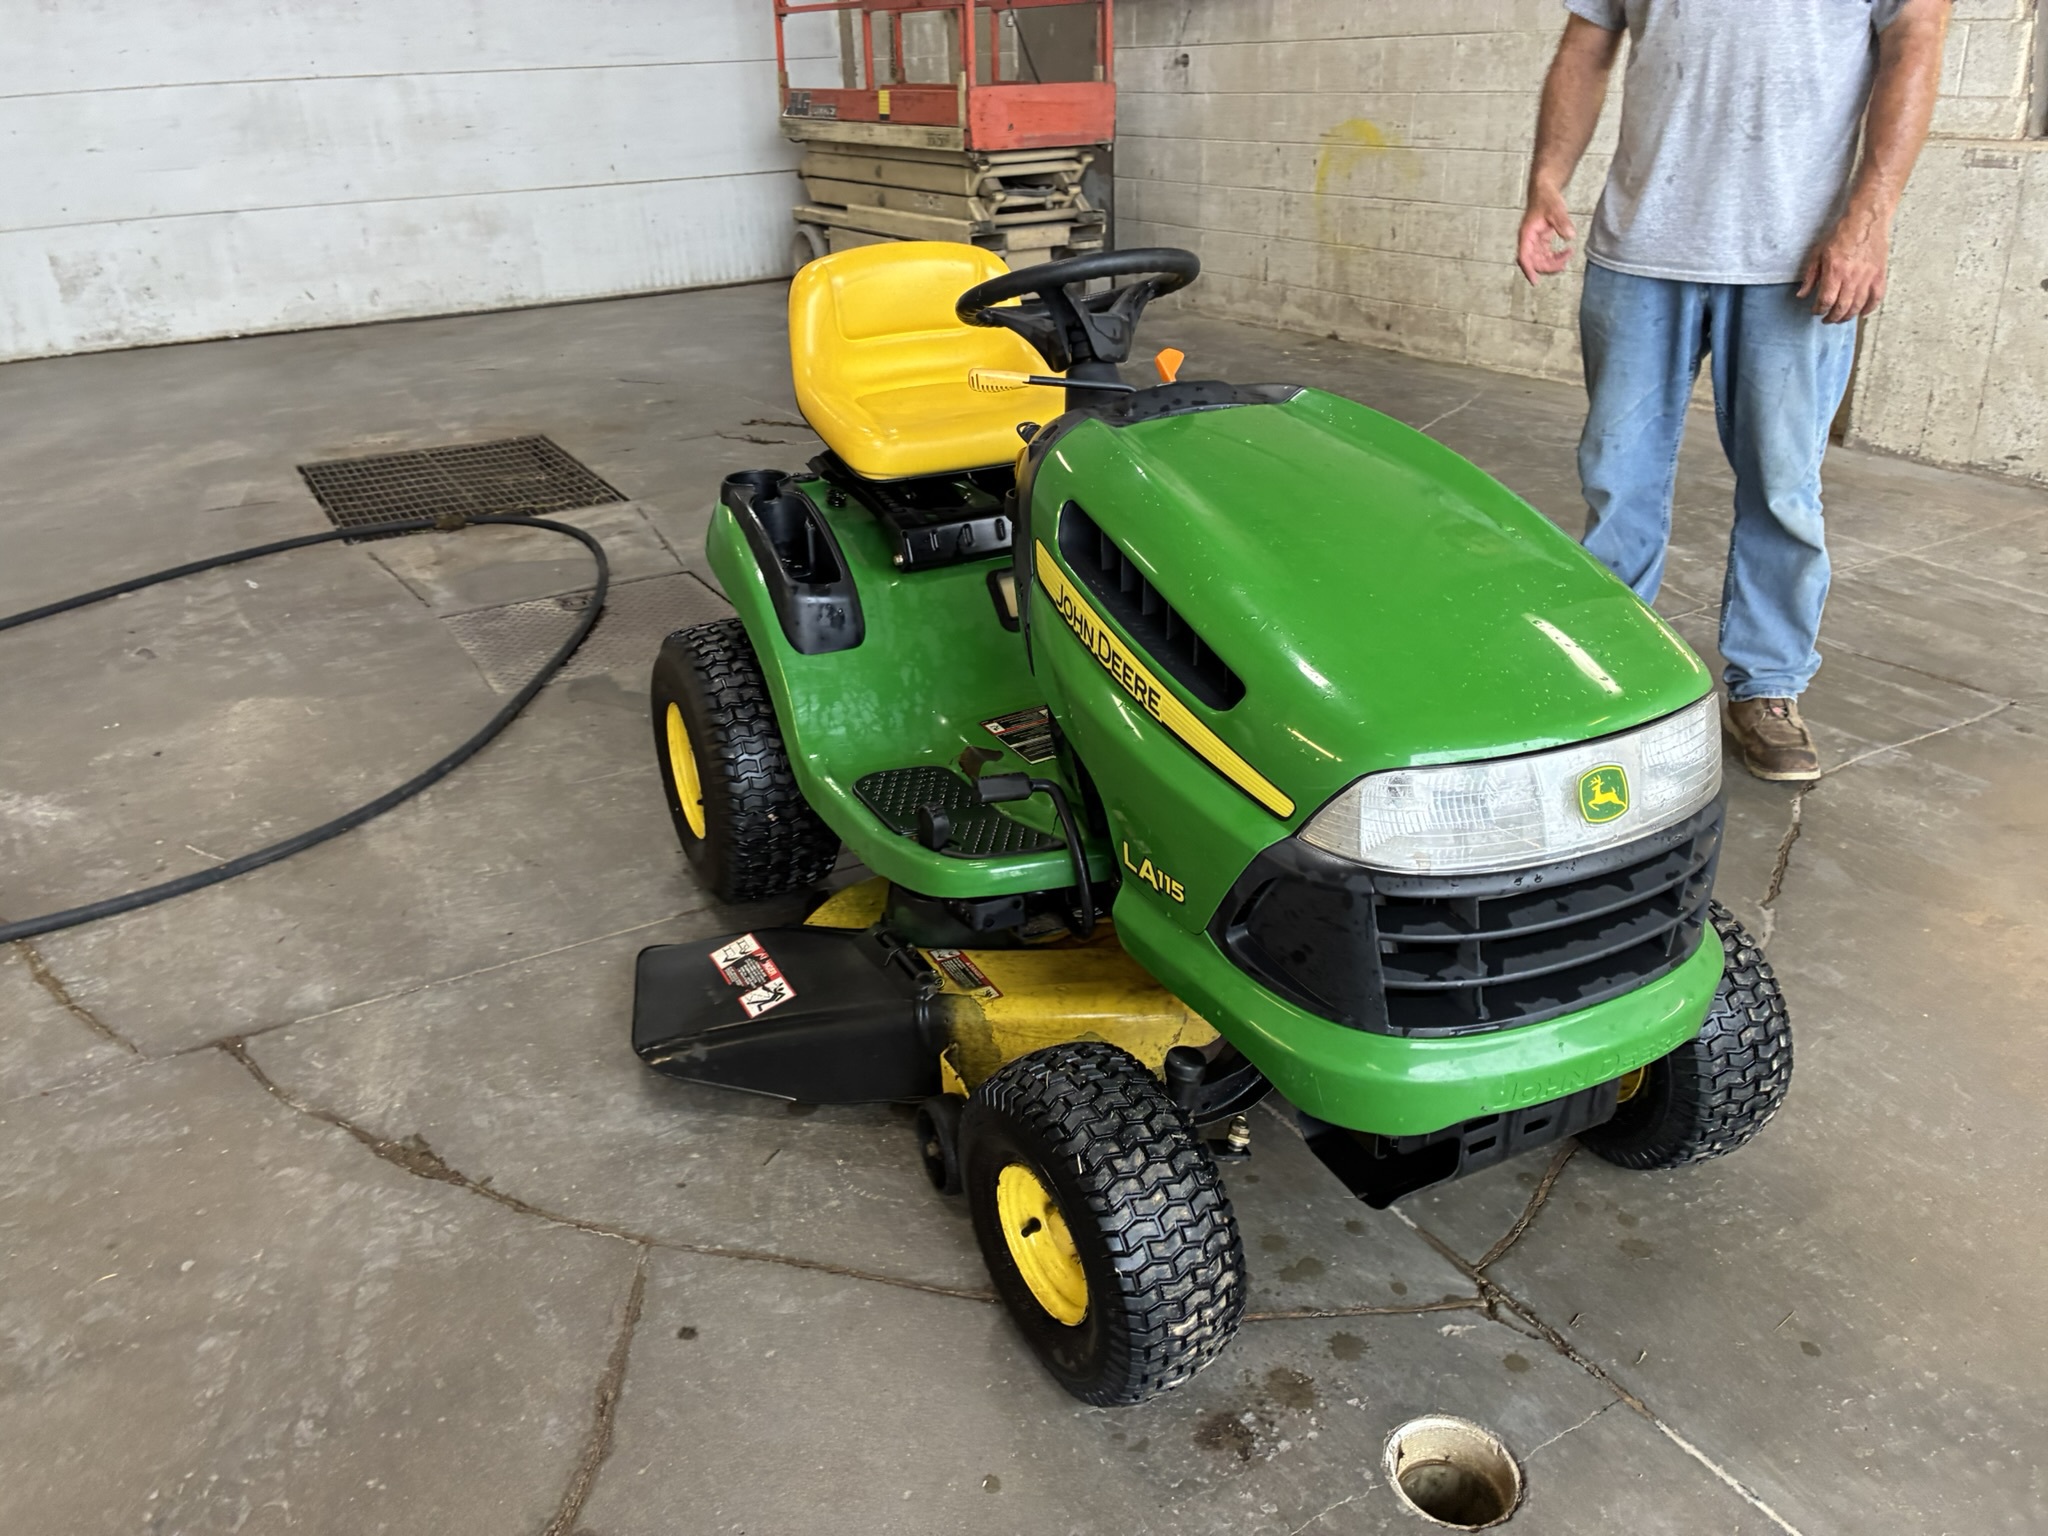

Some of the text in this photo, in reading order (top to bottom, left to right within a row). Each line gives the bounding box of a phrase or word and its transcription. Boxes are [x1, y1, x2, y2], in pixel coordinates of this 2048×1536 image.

[1055, 584, 1162, 717] JOHN DEERE
[1122, 840, 1186, 903] LA115
[1492, 1027, 1687, 1109] JOHN DEERE
